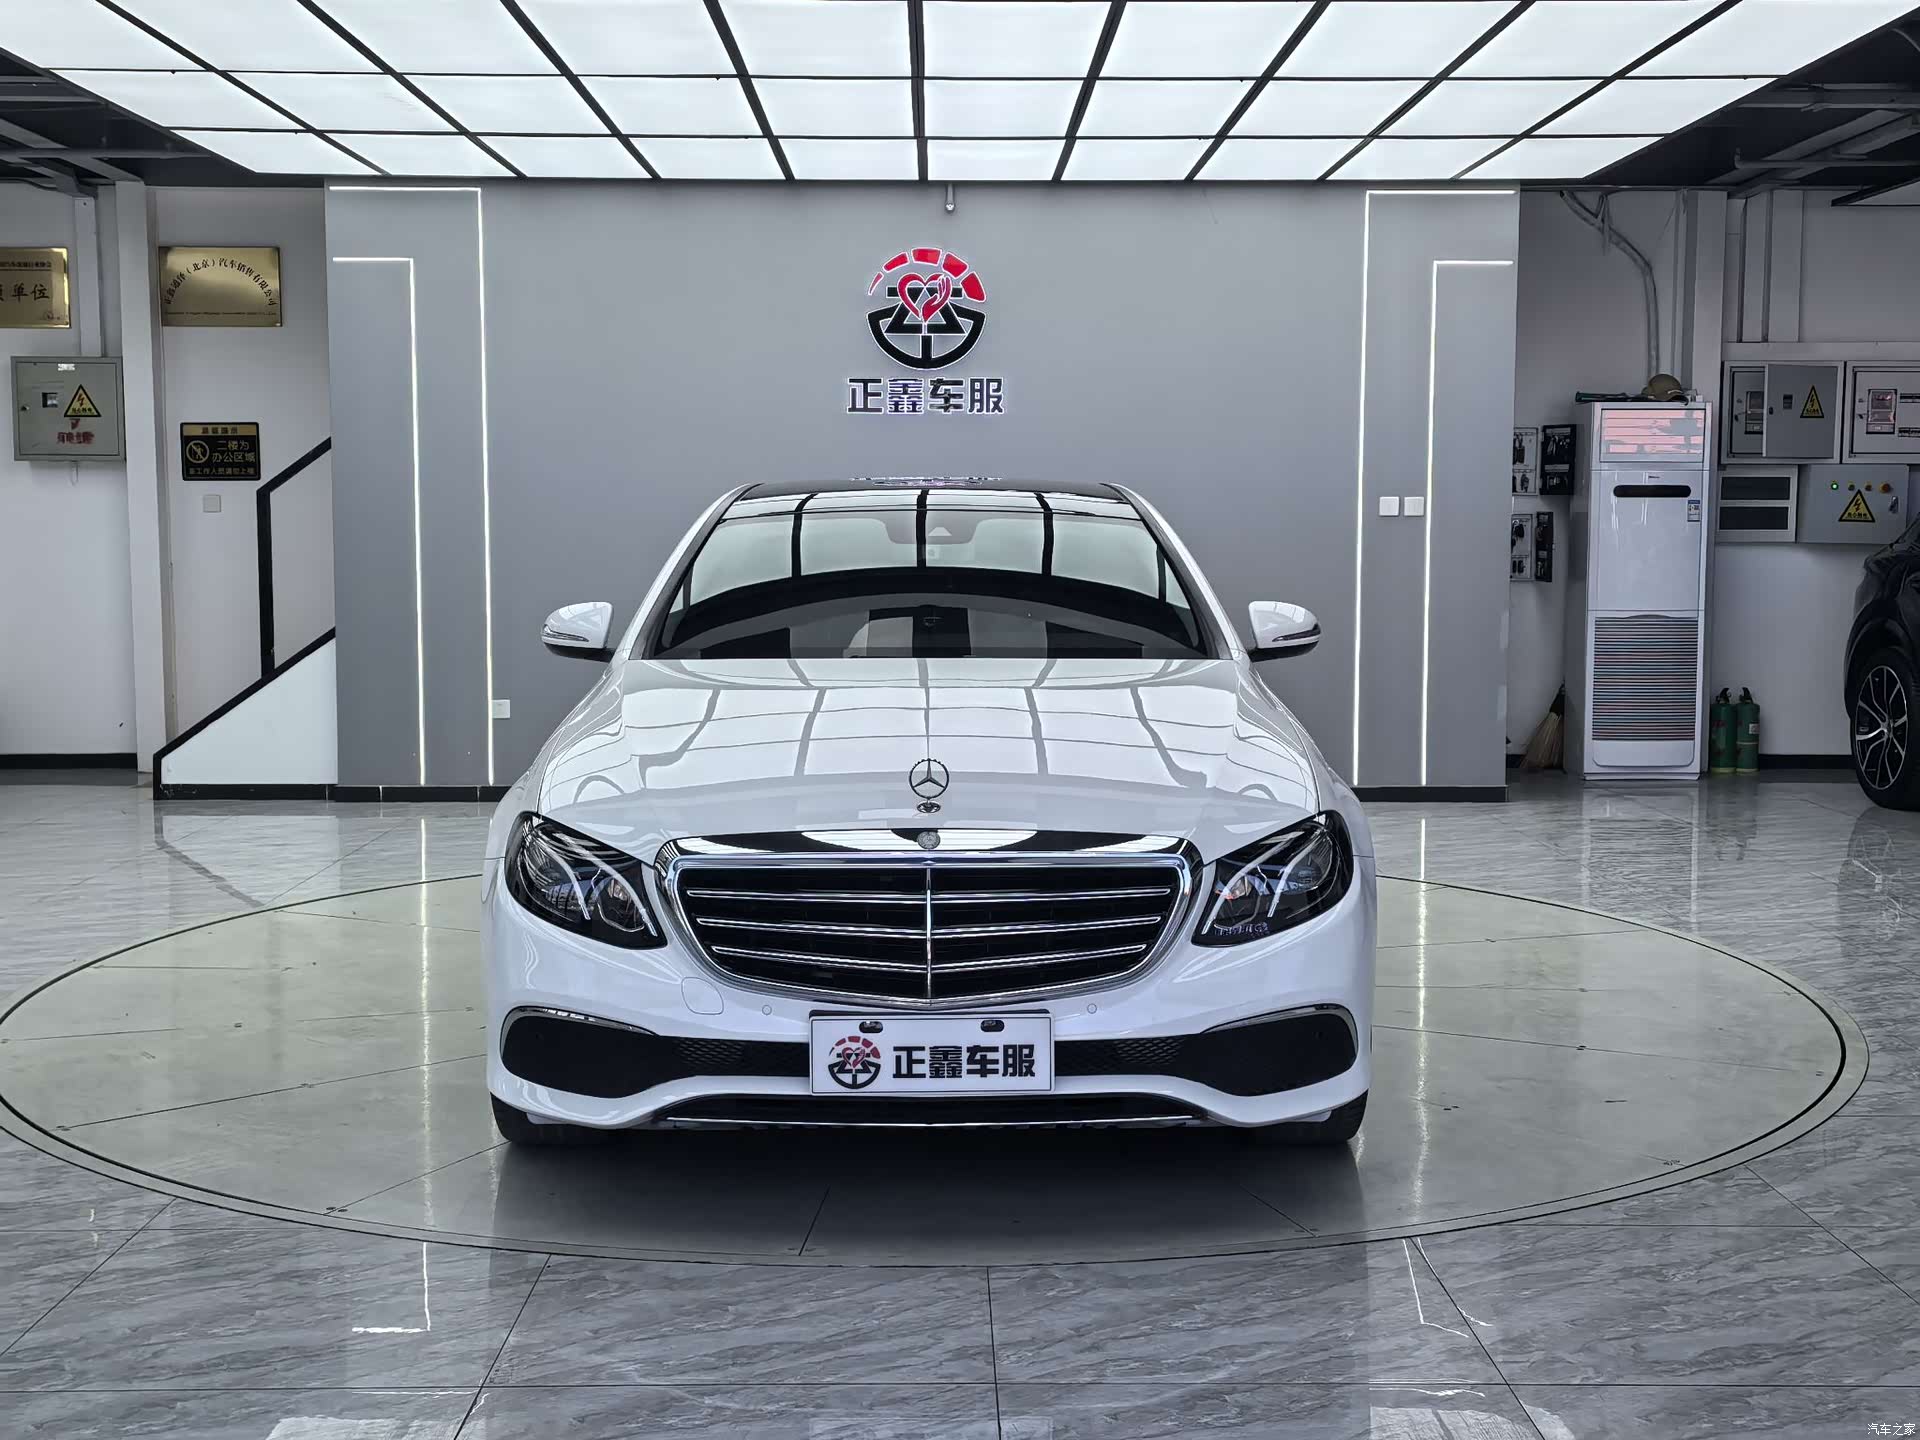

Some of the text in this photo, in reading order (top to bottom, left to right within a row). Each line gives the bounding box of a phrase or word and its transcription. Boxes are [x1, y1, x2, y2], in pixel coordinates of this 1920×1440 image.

[0, 282, 51, 302] 单位
[847, 377, 1004, 414] 正鑫车服
[216, 440, 250, 451] 二楼为
[211, 451, 256, 463] 办公区域
[892, 1044, 1036, 1079] 正鑫车服
